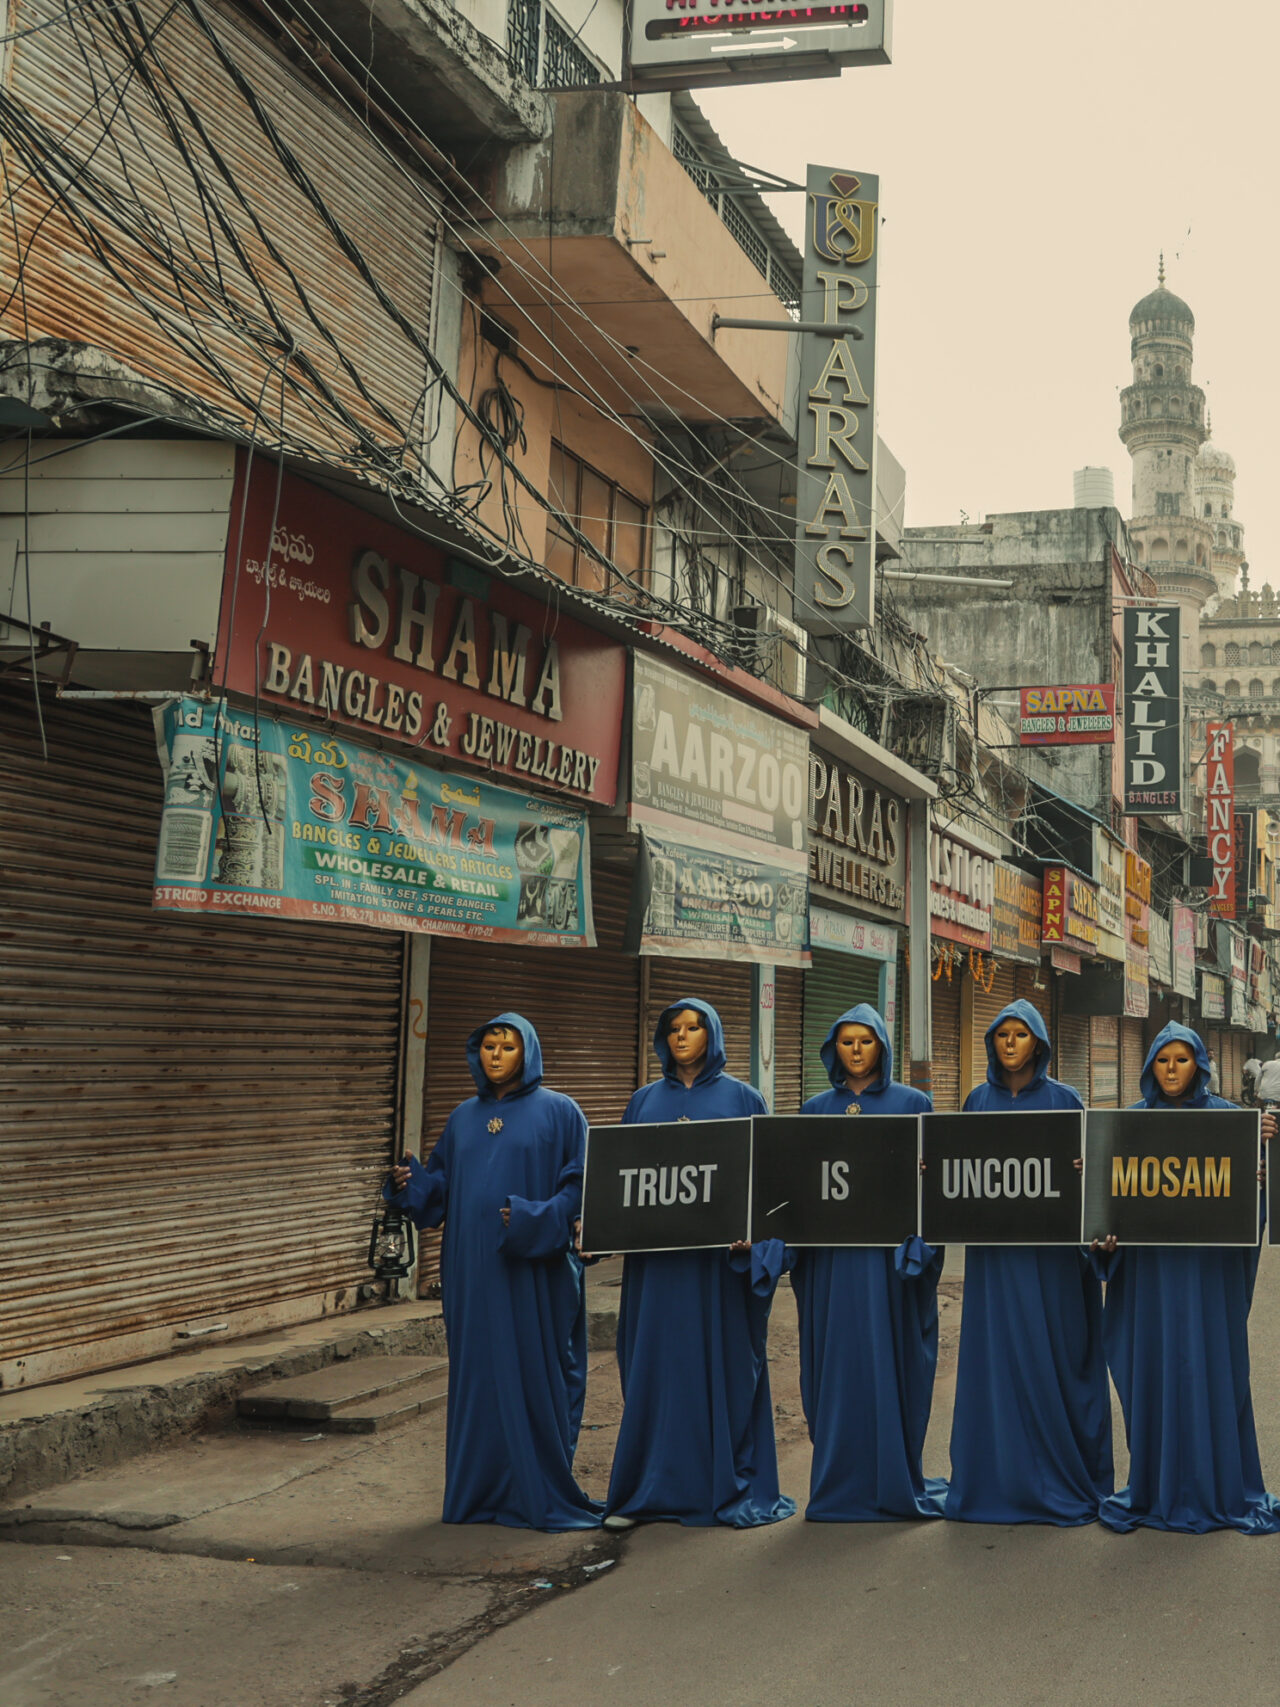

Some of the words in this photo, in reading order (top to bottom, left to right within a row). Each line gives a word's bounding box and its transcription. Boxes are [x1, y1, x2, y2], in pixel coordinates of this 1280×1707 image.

[806, 271, 870, 608] PARAS
[350, 548, 563, 722] SHAMA
[263, 641, 423, 736] BANGLES
[432, 702, 451, 747] &
[461, 712, 600, 793] JEWELLERY
[1026, 689, 1107, 714] SAPNA
[1130, 612, 1170, 785] KHALID
[1021, 717, 1055, 732] BANGLES
[1058, 717, 1065, 732] &
[1067, 715, 1112, 731] JEWELLERS
[650, 710, 803, 819] AARZOO
[309, 771, 498, 859] SHAMA
[808, 751, 899, 867] PARAS
[1129, 791, 1176, 805] BANGLES
[1210, 729, 1232, 900] FANCY
[292, 821, 361, 850] BANGLES
[367, 838, 380, 855] &
[386, 841, 457, 870] JEWELLERS
[460, 858, 514, 880] ARTICLES
[315, 851, 428, 886] WHOLESALE
[432, 874, 446, 889] &
[451, 877, 499, 897] RETAIL
[315, 875, 339, 888] SPL.
[360, 882, 394, 897] FAMILY
[396, 889, 418, 901] SET,
[421, 892, 454, 905] STONE
[456, 897, 497, 913] BANGLES,
[212, 891, 281, 909] EXCHANGE
[312, 903, 338, 917] S.NO.
[330, 891, 379, 906] IMITATION
[381, 897, 415, 912] STONE
[417, 903, 424, 913] &
[427, 905, 463, 918] PEARLS
[465, 910, 485, 921] ETC.
[1046, 870, 1061, 939] SAPNA
[619, 1163, 718, 1207] TRUST
[821, 1161, 850, 1200] IS
[942, 1157, 1061, 1198] UNCOOL
[1111, 1156, 1231, 1197] MOSAM
